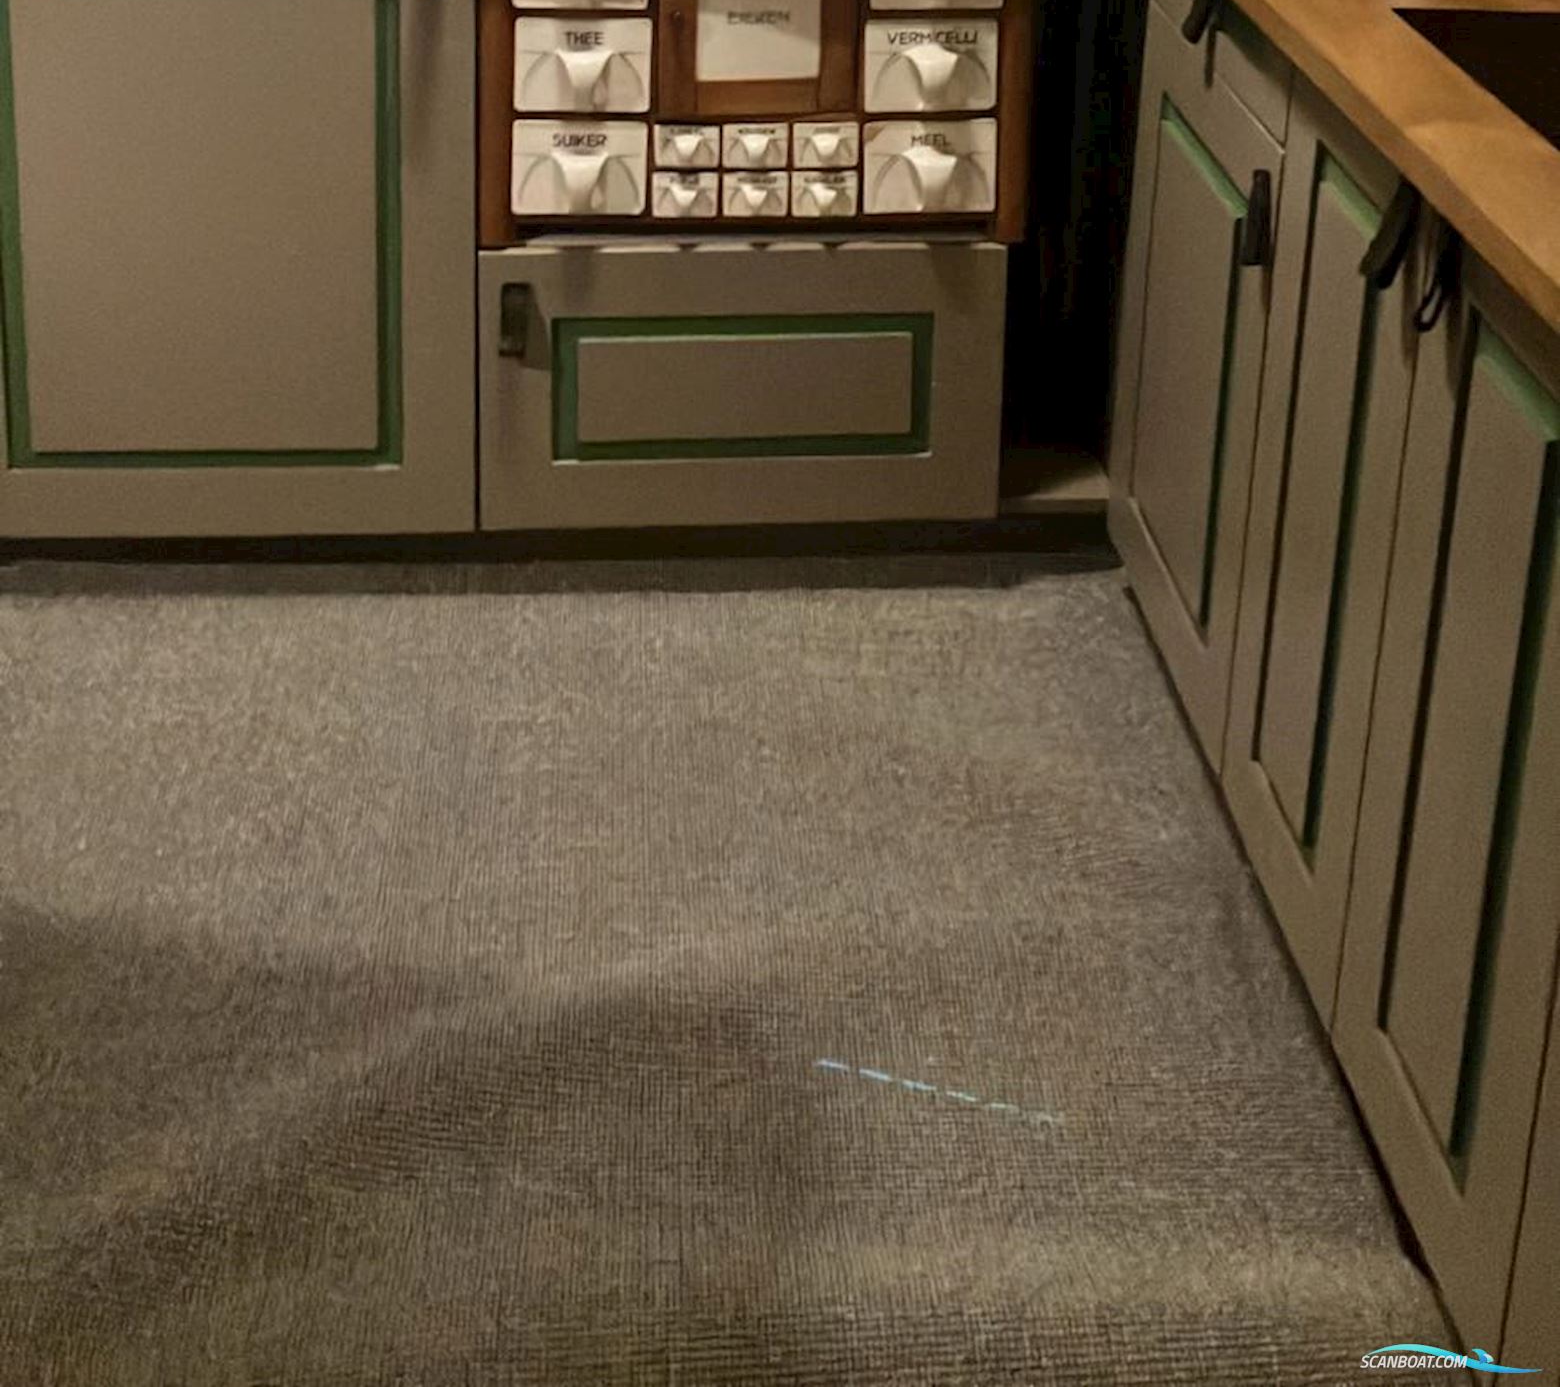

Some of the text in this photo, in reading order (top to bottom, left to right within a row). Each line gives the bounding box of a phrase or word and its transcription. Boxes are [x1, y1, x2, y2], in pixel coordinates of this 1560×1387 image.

[565, 31, 604, 45] THEE
[887, 30, 978, 45] VERMICELLI
[552, 133, 607, 147] SUIKER
